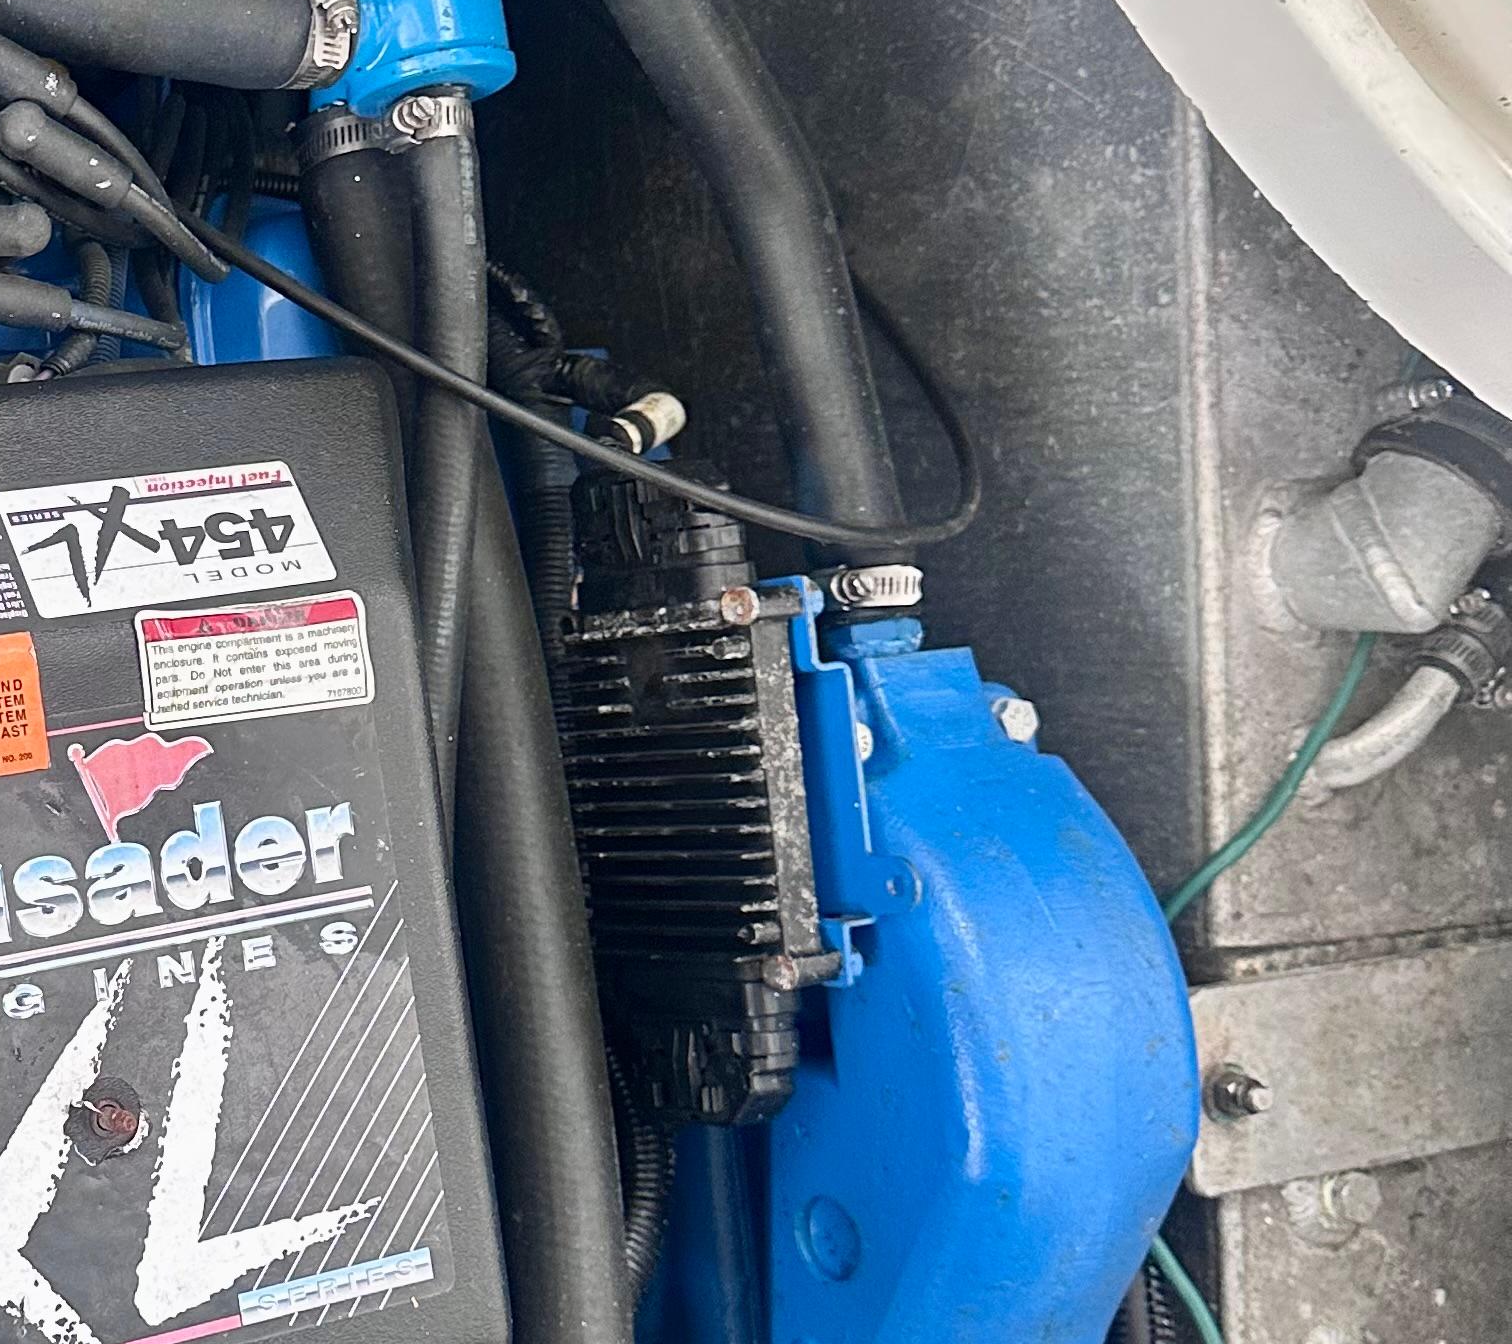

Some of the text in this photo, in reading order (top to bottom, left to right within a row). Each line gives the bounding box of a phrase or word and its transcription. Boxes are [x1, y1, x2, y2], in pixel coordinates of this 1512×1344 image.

[145, 467, 281, 499] Fuel Injection
[10, 508, 61, 524] SERIES
[12, 480, 298, 615] 454 XL
[182, 557, 301, 586] MODEL
[151, 643, 174, 655] This
[177, 639, 211, 654] engine
[215, 630, 281, 651] compartment
[225, 648, 268, 663] contains
[275, 642, 317, 658] exposed
[323, 637, 357, 652] moving
[190, 669, 205, 681] Do
[213, 666, 232, 678] Not
[239, 663, 266, 675] enter
[273, 660, 291, 671] this
[298, 657, 321, 668] area
[327, 651, 358, 666] during
[215, 677, 263, 695] operation
[308, 671, 326, 683] you
[332, 669, 348, 678] are
[192, 696, 228, 710] service
[255, 1255, 420, 1315] SERIES
